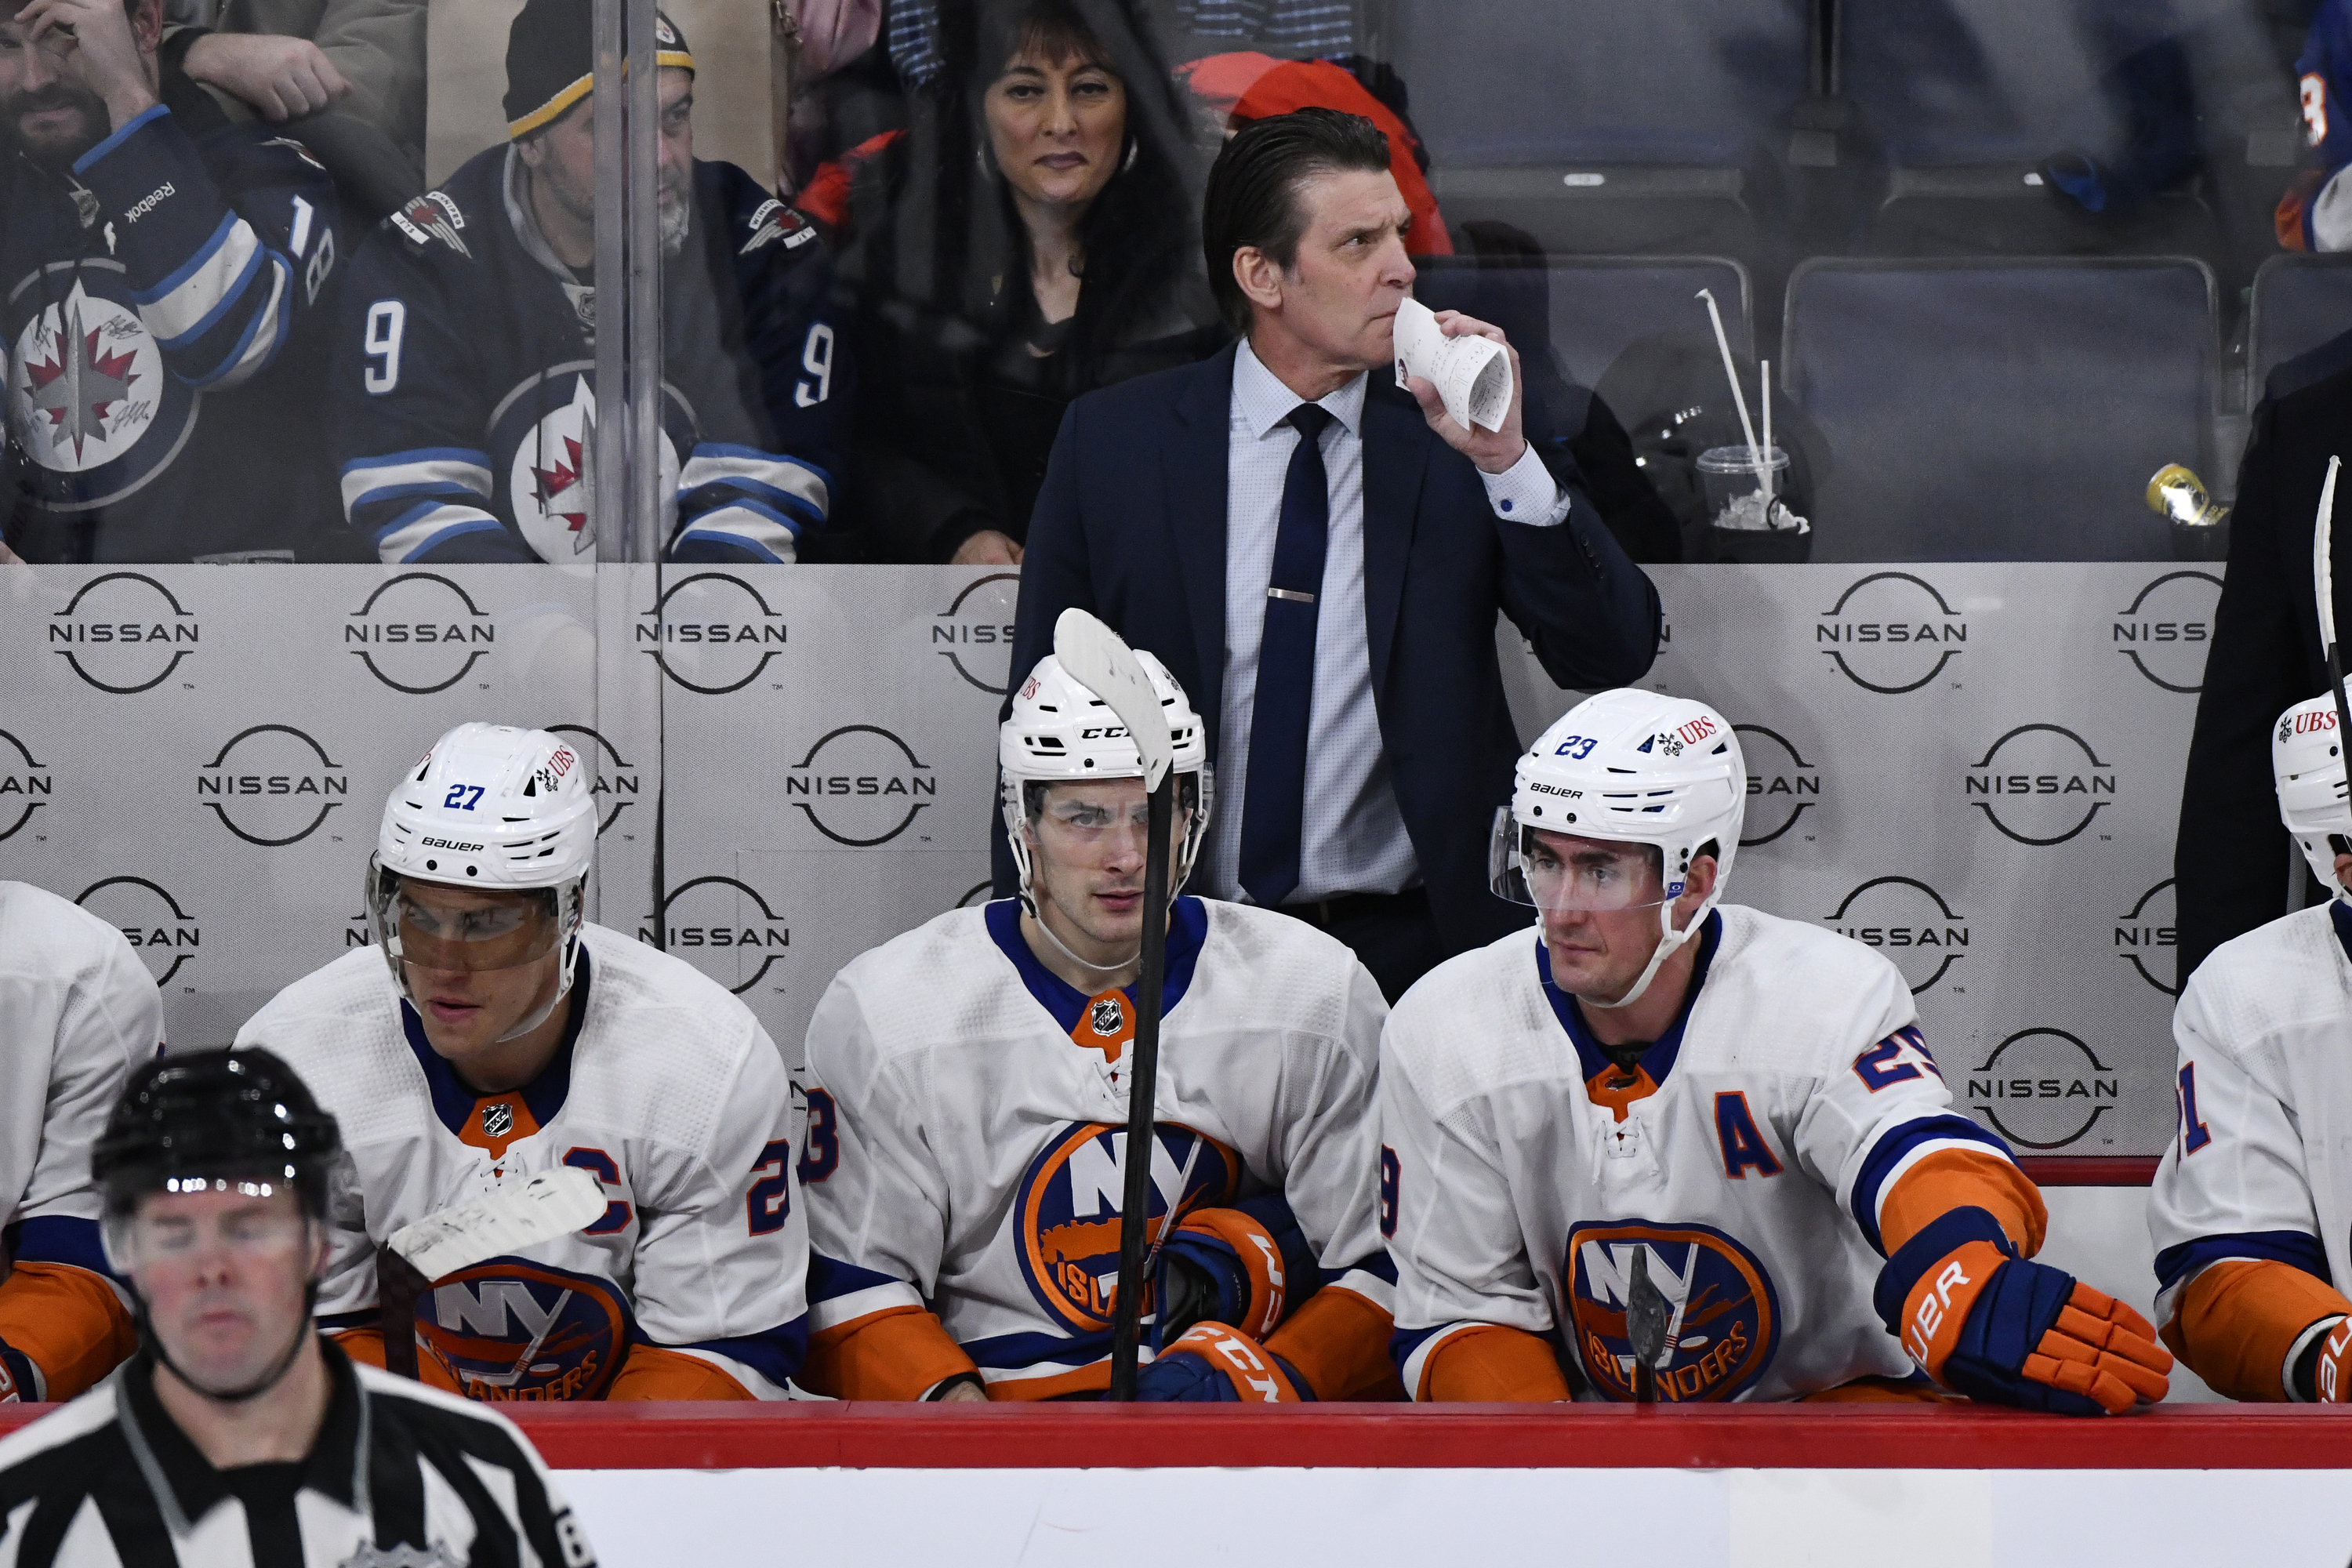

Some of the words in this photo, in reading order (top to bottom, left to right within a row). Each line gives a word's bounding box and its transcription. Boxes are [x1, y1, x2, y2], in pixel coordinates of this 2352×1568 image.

[124, 181, 176, 223] Reebok
[364, 299, 407, 394] 9
[795, 321, 834, 408] 9
[50, 624, 198, 642] NISSAN
[346, 625, 494, 642] NISSAN
[637, 624, 787, 642] NISSAN
[933, 626, 1014, 643] NISS
[1817, 624, 1966, 641] NISSAN
[2114, 623, 2207, 641] NISS
[1081, 727, 1131, 739] CC
[1676, 716, 1718, 745] UBS
[2295, 710, 2338, 734] UBS
[1555, 735, 1598, 760] 29
[548, 745, 575, 777] UBS
[198, 776, 347, 794] NISSAN
[787, 777, 936, 794] NISSAN
[1747, 776, 1819, 794] SAN
[1966, 776, 2115, 793] NISSAN
[444, 784, 485, 811] 27
[122, 928, 199, 946] SAN
[1837, 928, 1969, 946] ISSAN
[2115, 928, 2177, 946] NIS
[1969, 1080, 2118, 1098] NISSAN
[2175, 1061, 2212, 1174] 1
[797, 1087, 840, 1186] 3
[1715, 1091, 1784, 1179] A
[1069, 1131, 1204, 1250] NY
[1247, 1233, 1283, 1342] CM
[1581, 1240, 1700, 1337] NY
[434, 1281, 573, 1360] NY
[1907, 1261, 1971, 1378] UER
